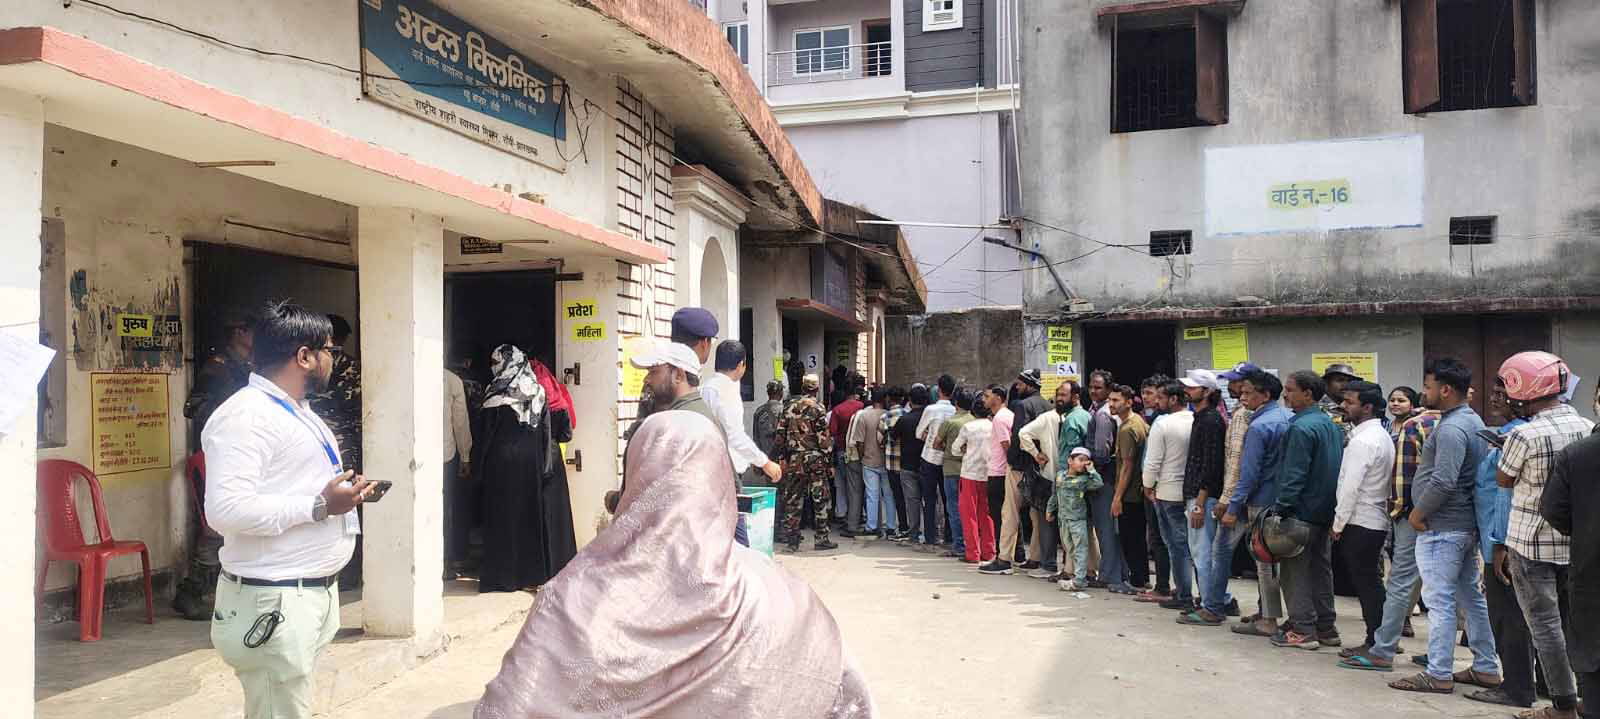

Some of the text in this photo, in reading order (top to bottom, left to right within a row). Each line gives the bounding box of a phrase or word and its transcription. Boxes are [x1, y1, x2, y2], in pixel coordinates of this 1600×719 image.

[395, 4, 462, 62] अटल
[467, 31, 546, 104] क्लिनिक
[414, 98, 437, 119] राष्ट्रीय
[438, 107, 457, 125] शहरी
[1271, 183, 1298, 206] वार्ड
[567, 302, 593, 318] प्रवेश
[122, 317, 149, 333] पुरुष
[576, 325, 602, 338] महिला
[808, 355, 817, 369] 3
